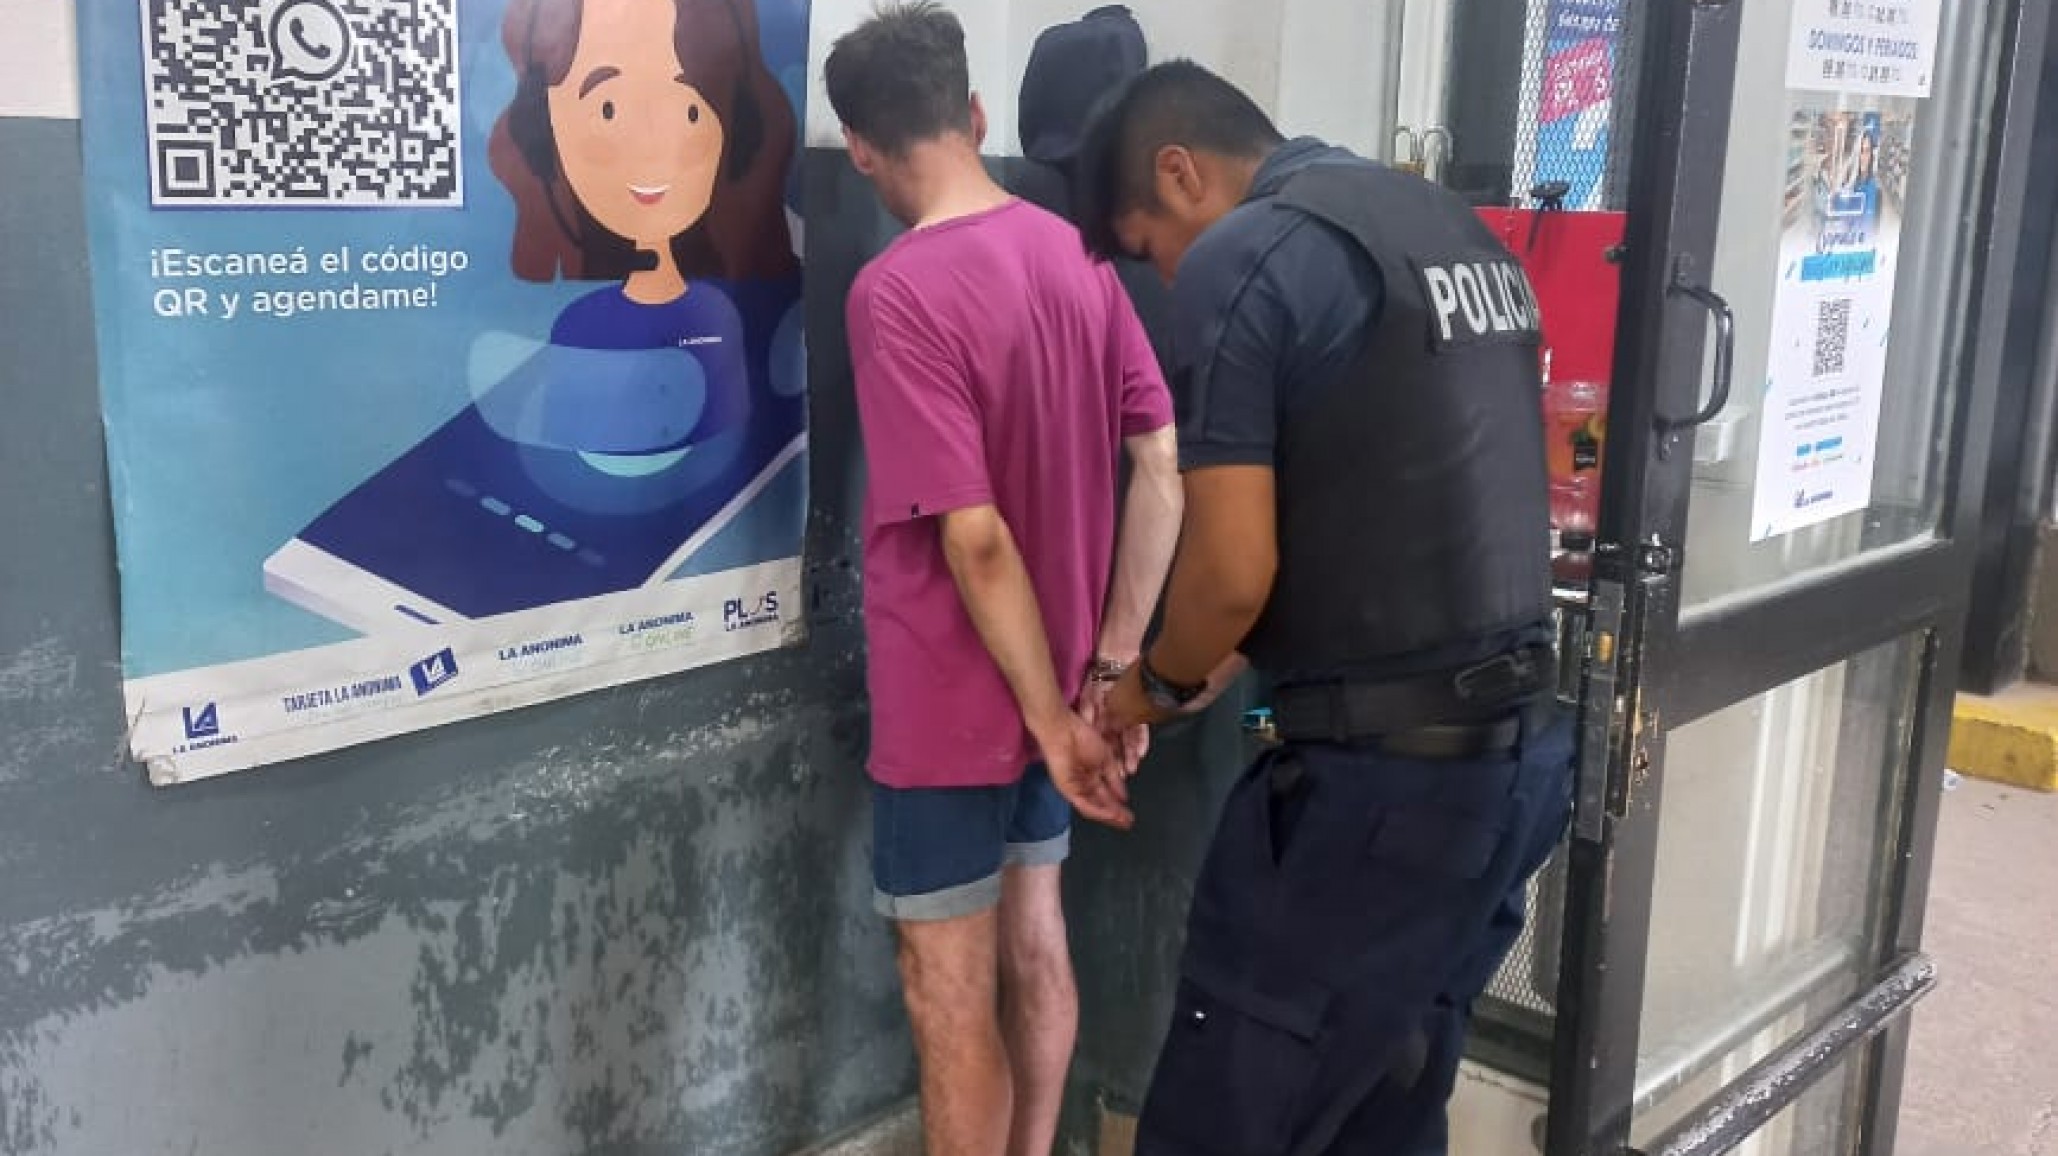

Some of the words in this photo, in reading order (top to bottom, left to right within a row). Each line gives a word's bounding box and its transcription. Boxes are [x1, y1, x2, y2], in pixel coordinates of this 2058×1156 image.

[151, 246, 309, 278] ¡Escaneá
[320, 246, 350, 273] el
[361, 244, 469, 277] código
[153, 288, 209, 318] QR
[220, 294, 239, 319] y
[252, 282, 438, 318] agendame!
[283, 689, 333, 713] TARJETA
[334, 685, 350, 704] LA
